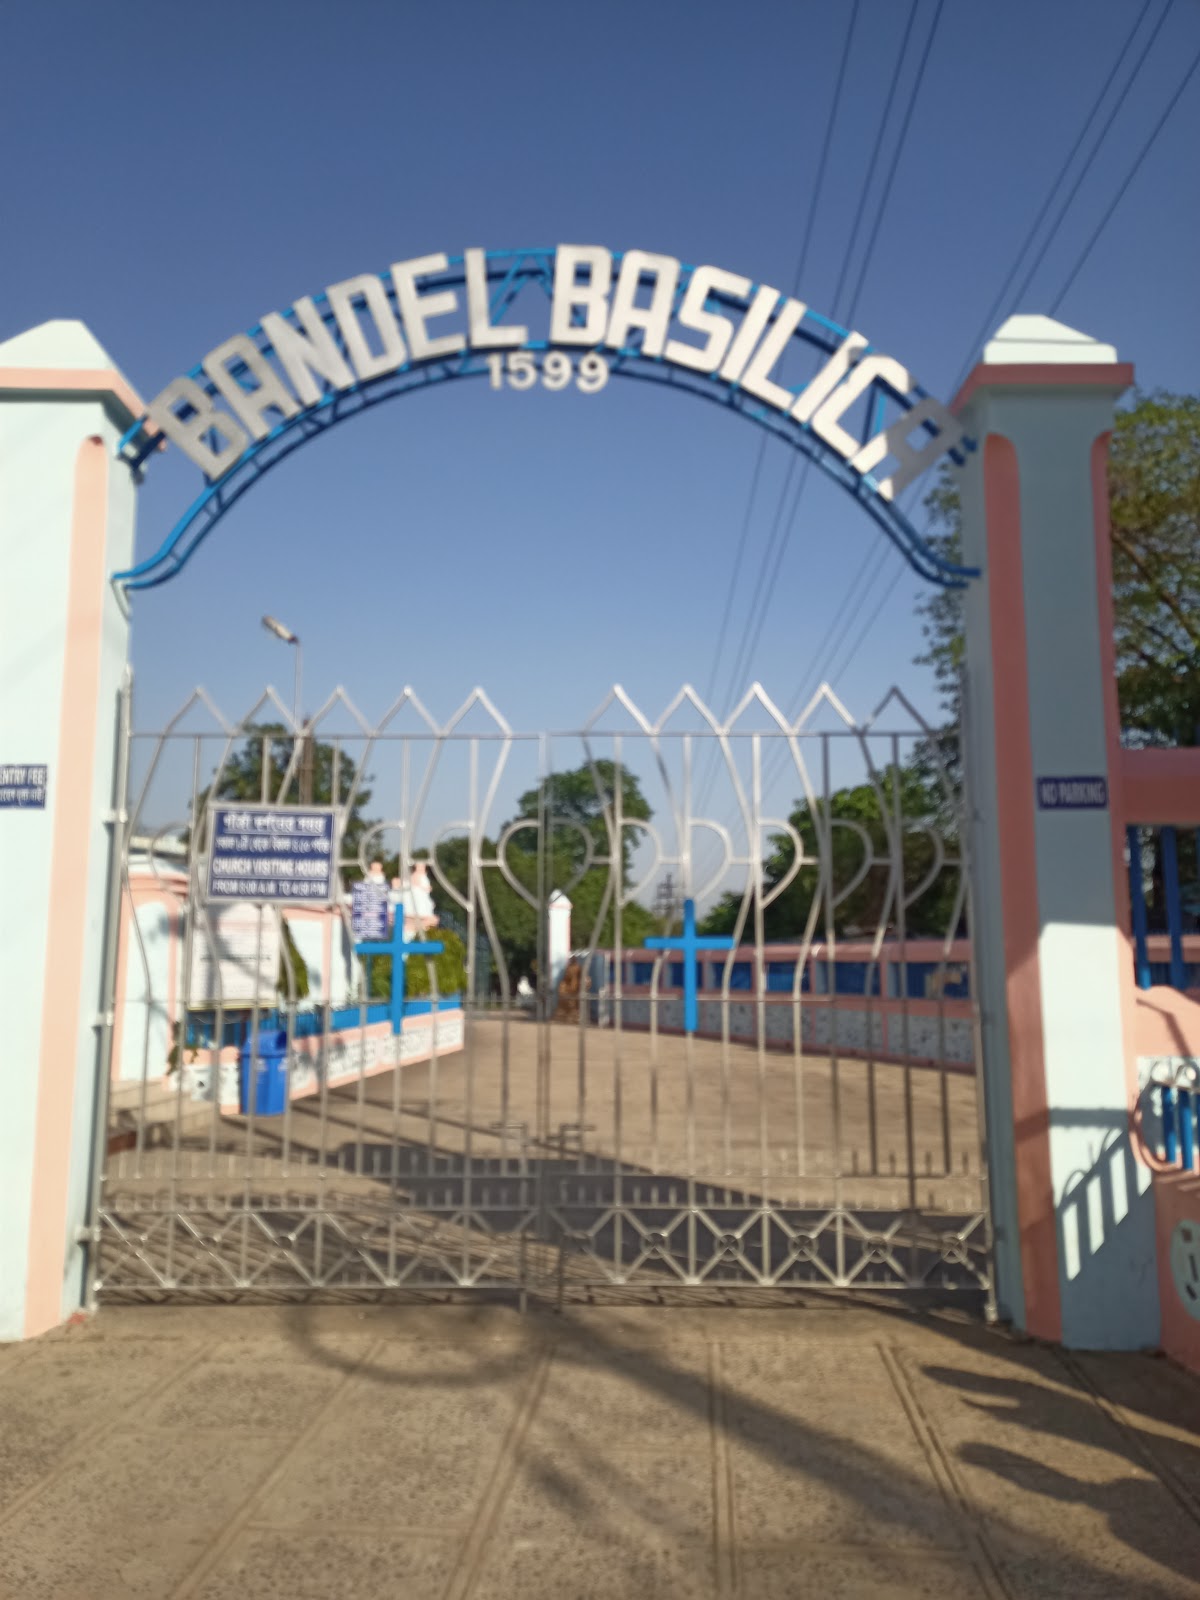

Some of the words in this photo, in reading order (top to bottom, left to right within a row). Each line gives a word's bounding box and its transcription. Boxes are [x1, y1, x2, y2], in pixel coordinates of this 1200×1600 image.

[152, 247, 529, 480] BANDEL
[550, 244, 962, 500] BASILICA
[486, 351, 611, 392] 1599
[27, 768, 43, 785] FEE
[1041, 783, 1057, 804] NO
[1058, 782, 1105, 804] PARKING
[213, 857, 252, 875] CHURCH
[253, 858, 294, 876] VISITING
[295, 859, 329, 877] HOURS
[213, 879, 238, 894] FROM
[279, 880, 292, 895] TO
